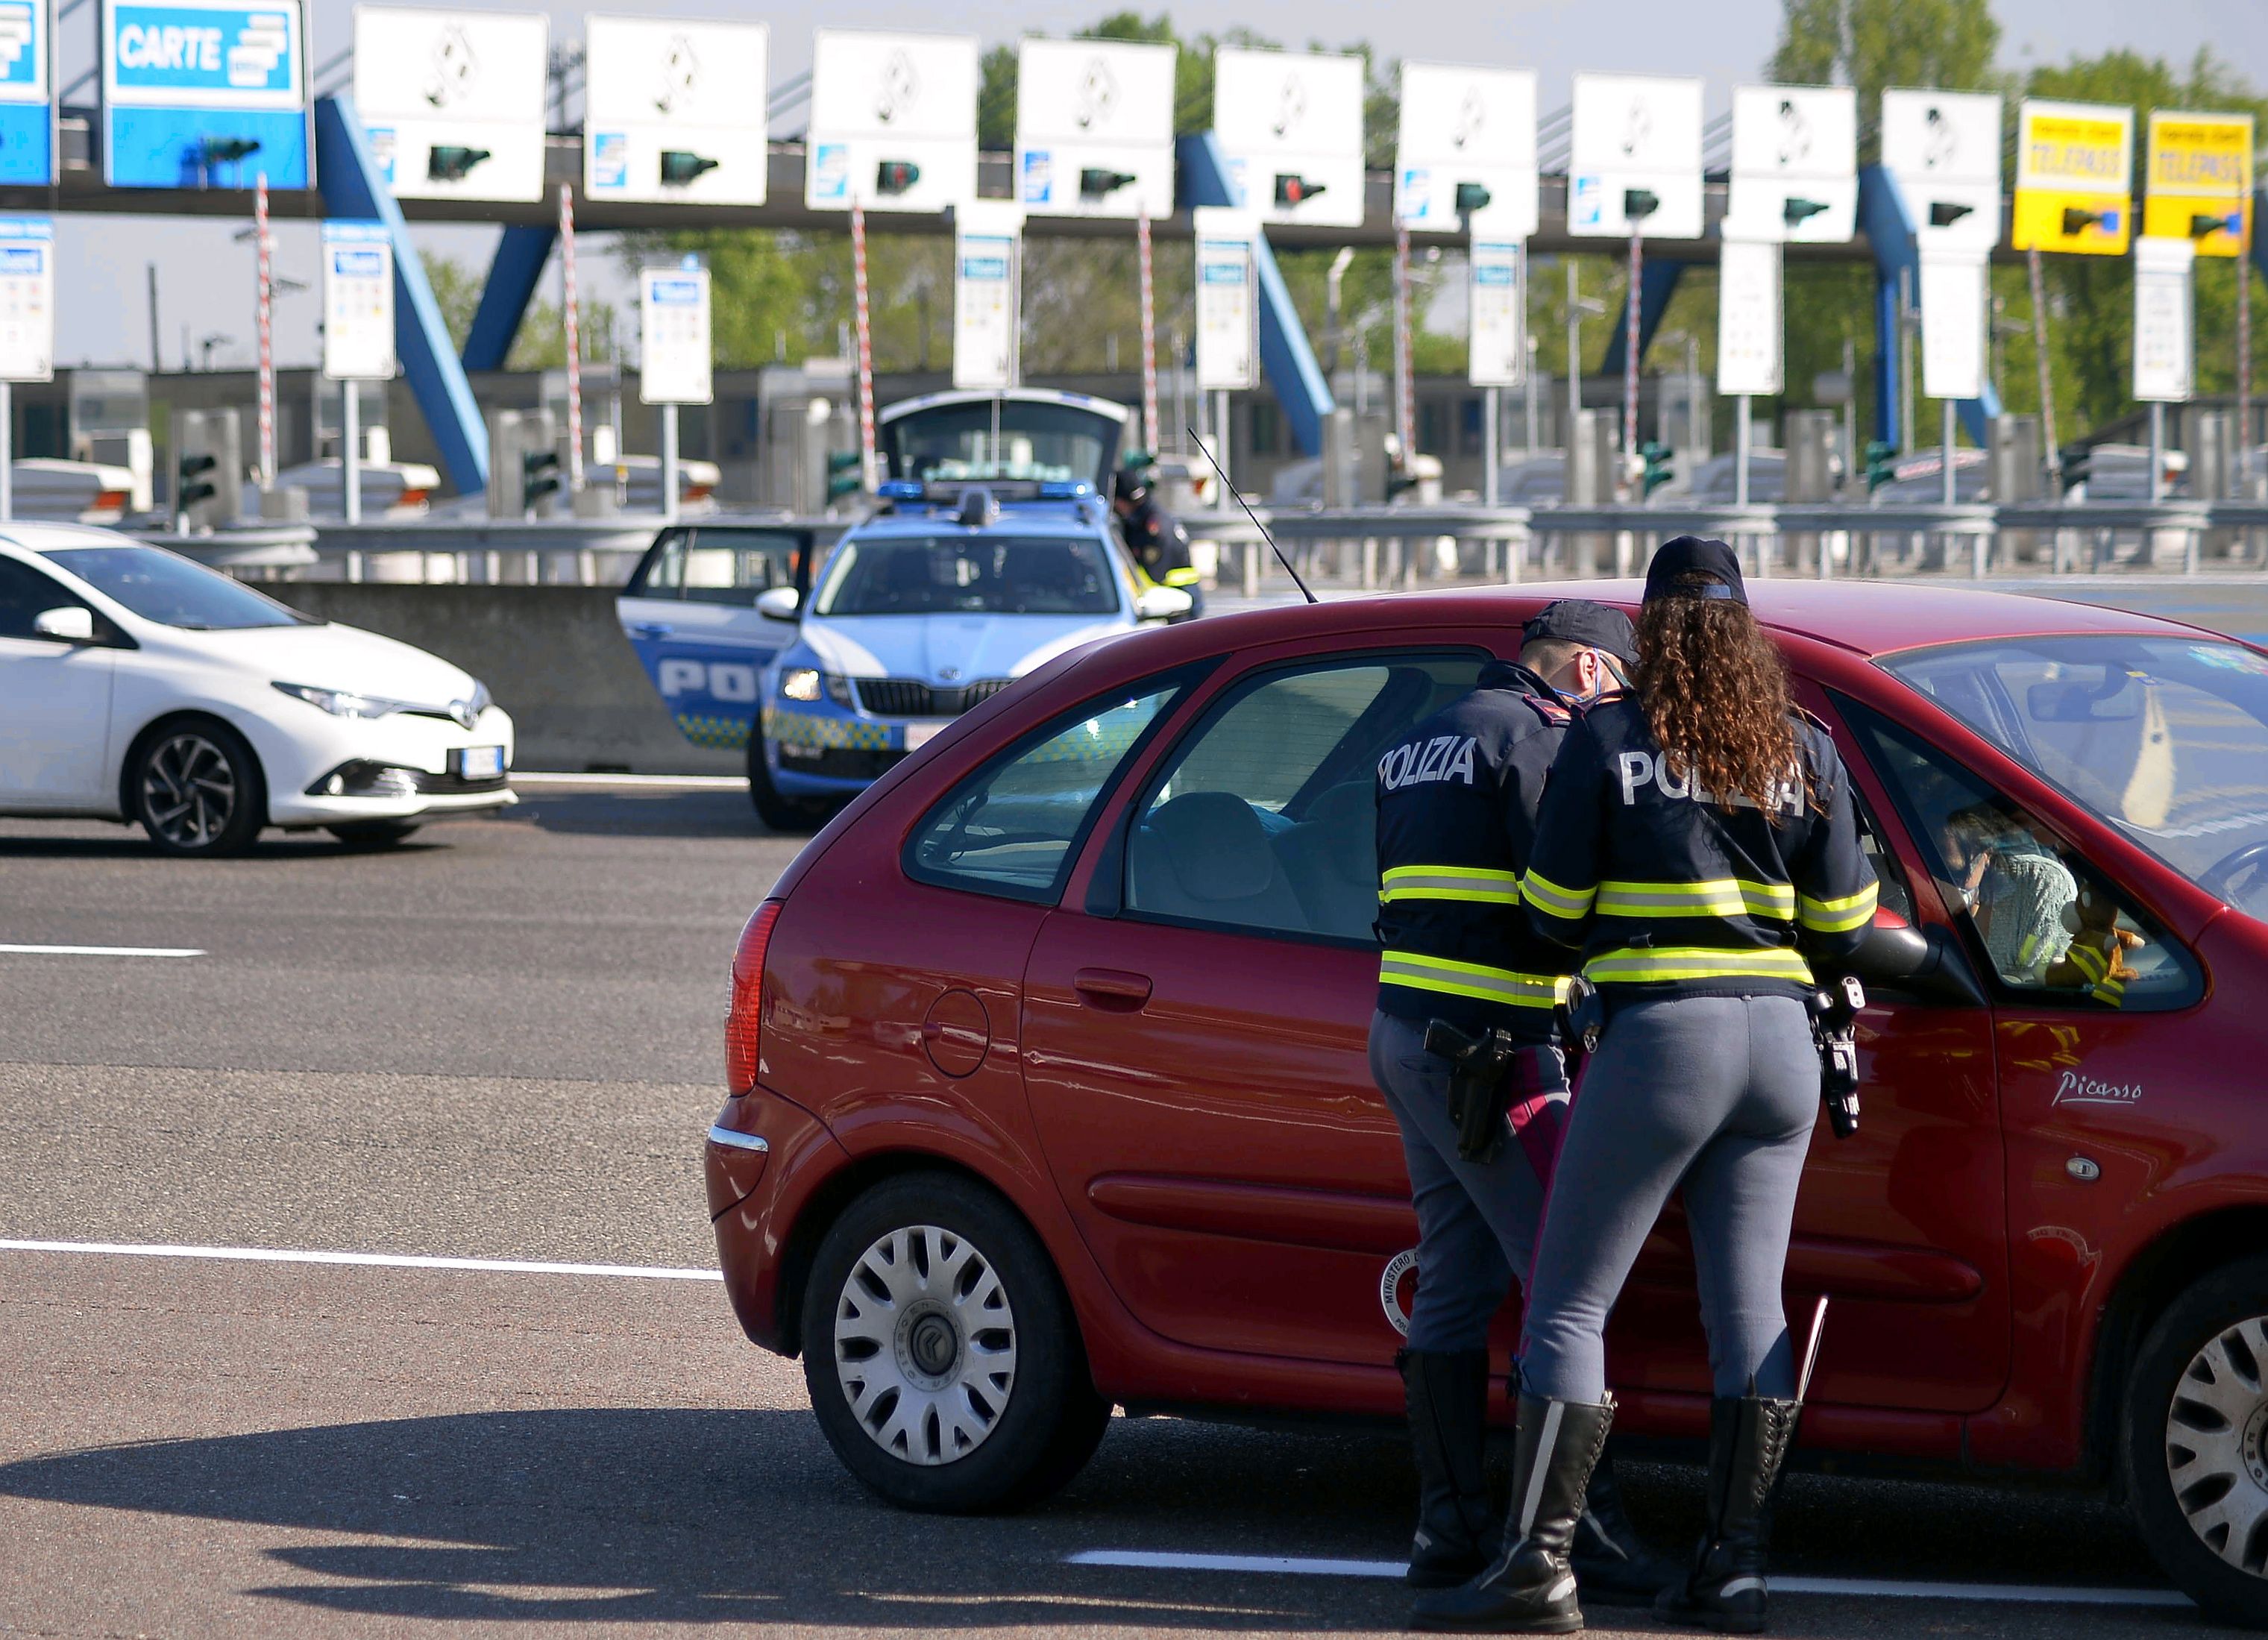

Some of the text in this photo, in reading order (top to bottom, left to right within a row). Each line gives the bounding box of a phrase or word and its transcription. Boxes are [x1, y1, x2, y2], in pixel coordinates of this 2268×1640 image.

[119, 25, 222, 71] CARTE
[1378, 735, 1477, 791] POLIZIA
[2051, 1070, 2142, 1108] Picasso
[1385, 1254, 1410, 1304] MINISTERO
